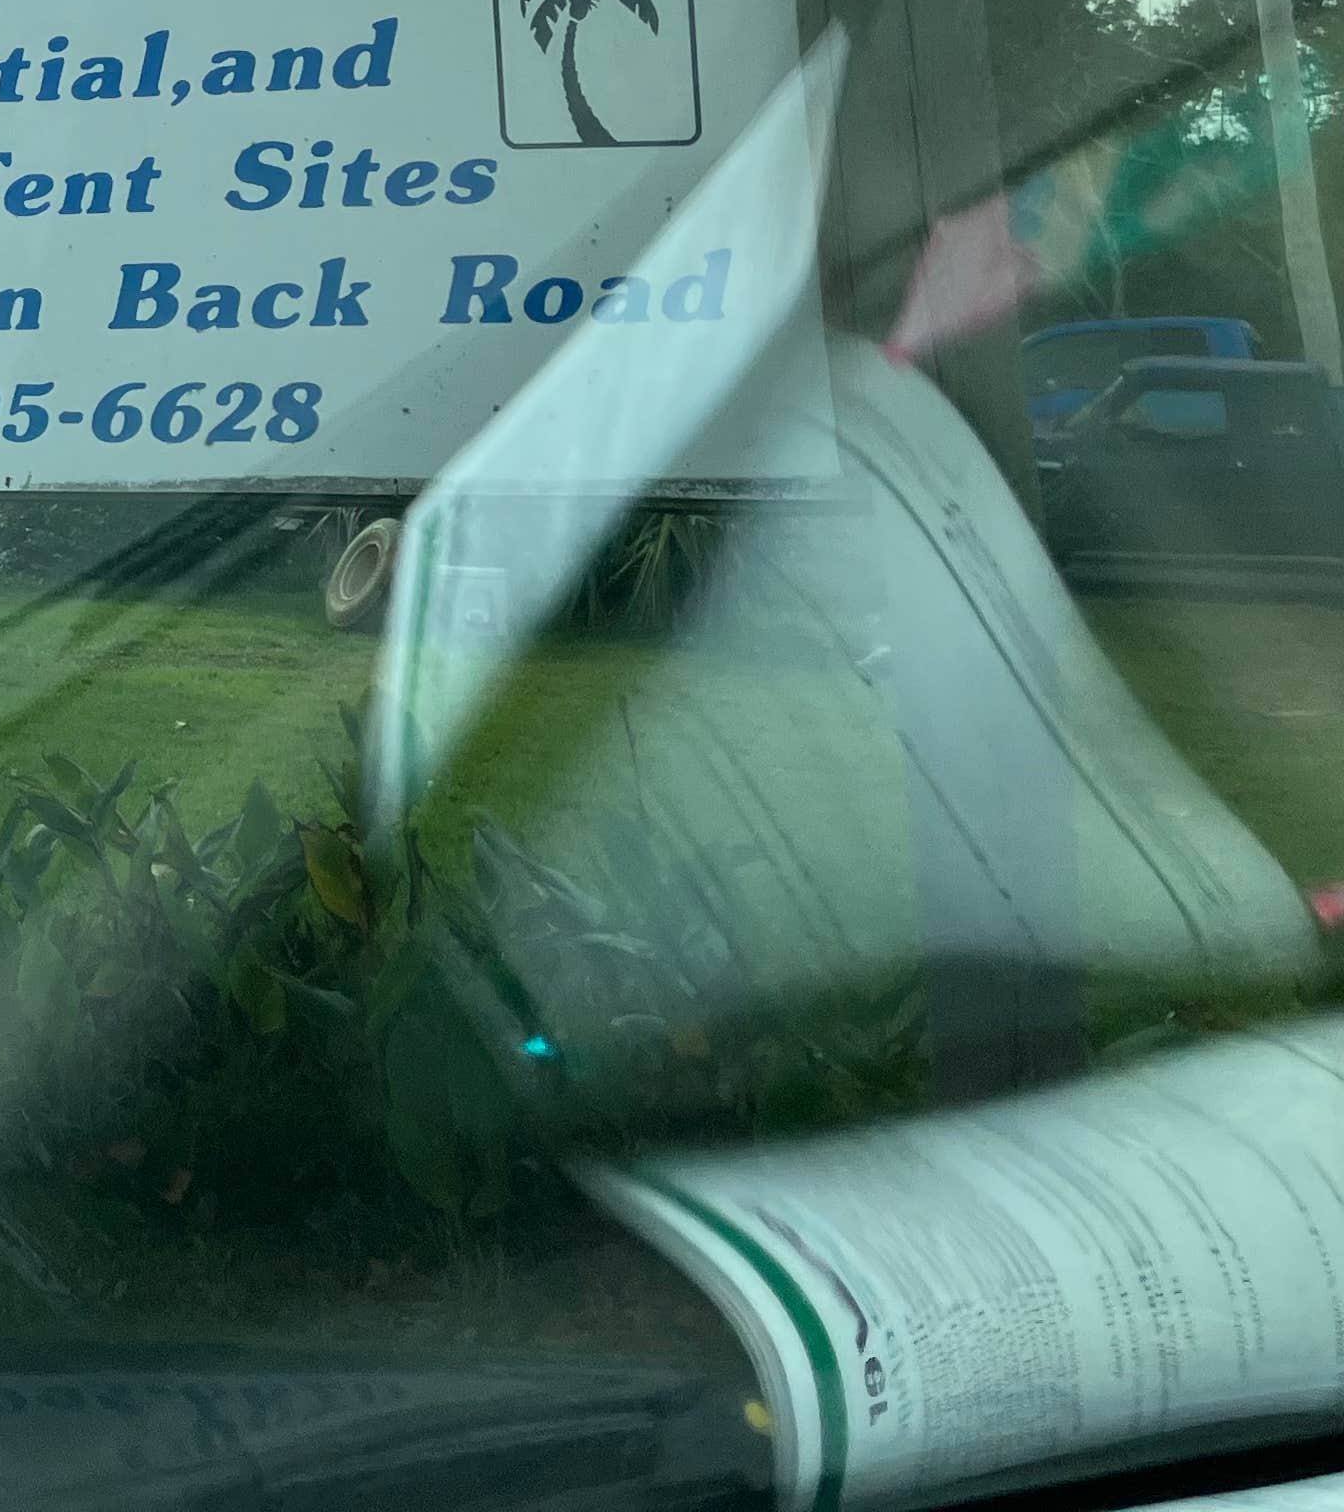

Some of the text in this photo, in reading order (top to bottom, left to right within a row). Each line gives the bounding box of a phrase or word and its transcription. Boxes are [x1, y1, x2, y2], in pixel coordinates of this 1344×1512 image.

[224, 139, 497, 212] Sites
[107, 257, 373, 333] Back
[439, 247, 732, 326] Road
